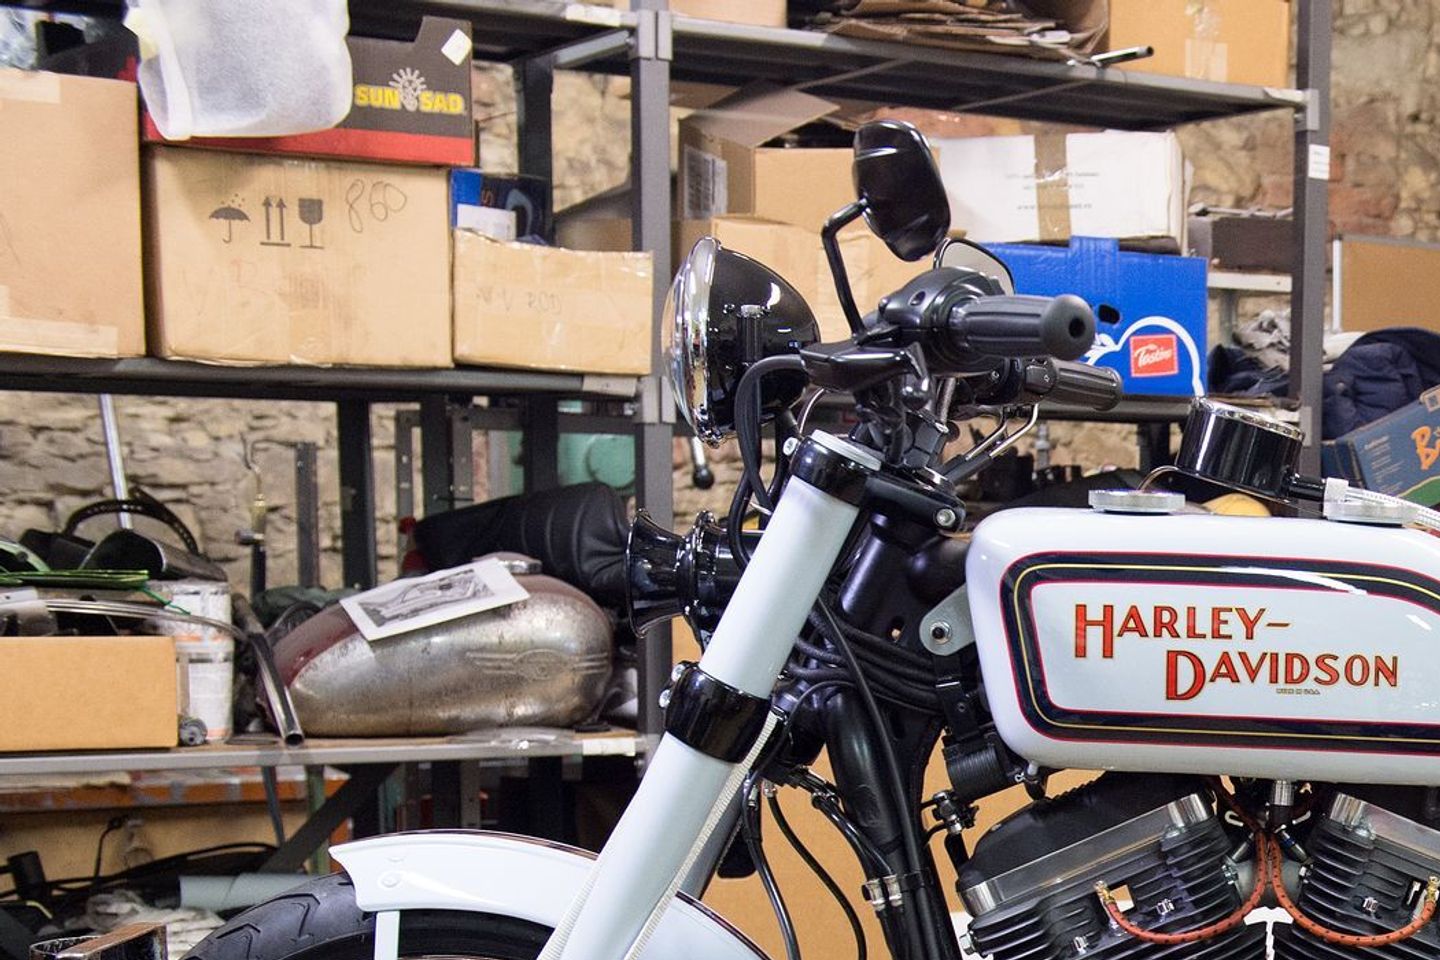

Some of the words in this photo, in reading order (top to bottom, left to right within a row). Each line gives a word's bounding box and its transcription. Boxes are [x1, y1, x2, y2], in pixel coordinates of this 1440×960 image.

[354, 84, 400, 109] SUN
[419, 90, 465, 115] SAD
[346, 178, 408, 233] 860
[1165, 649, 1398, 700] DAVIDSON
